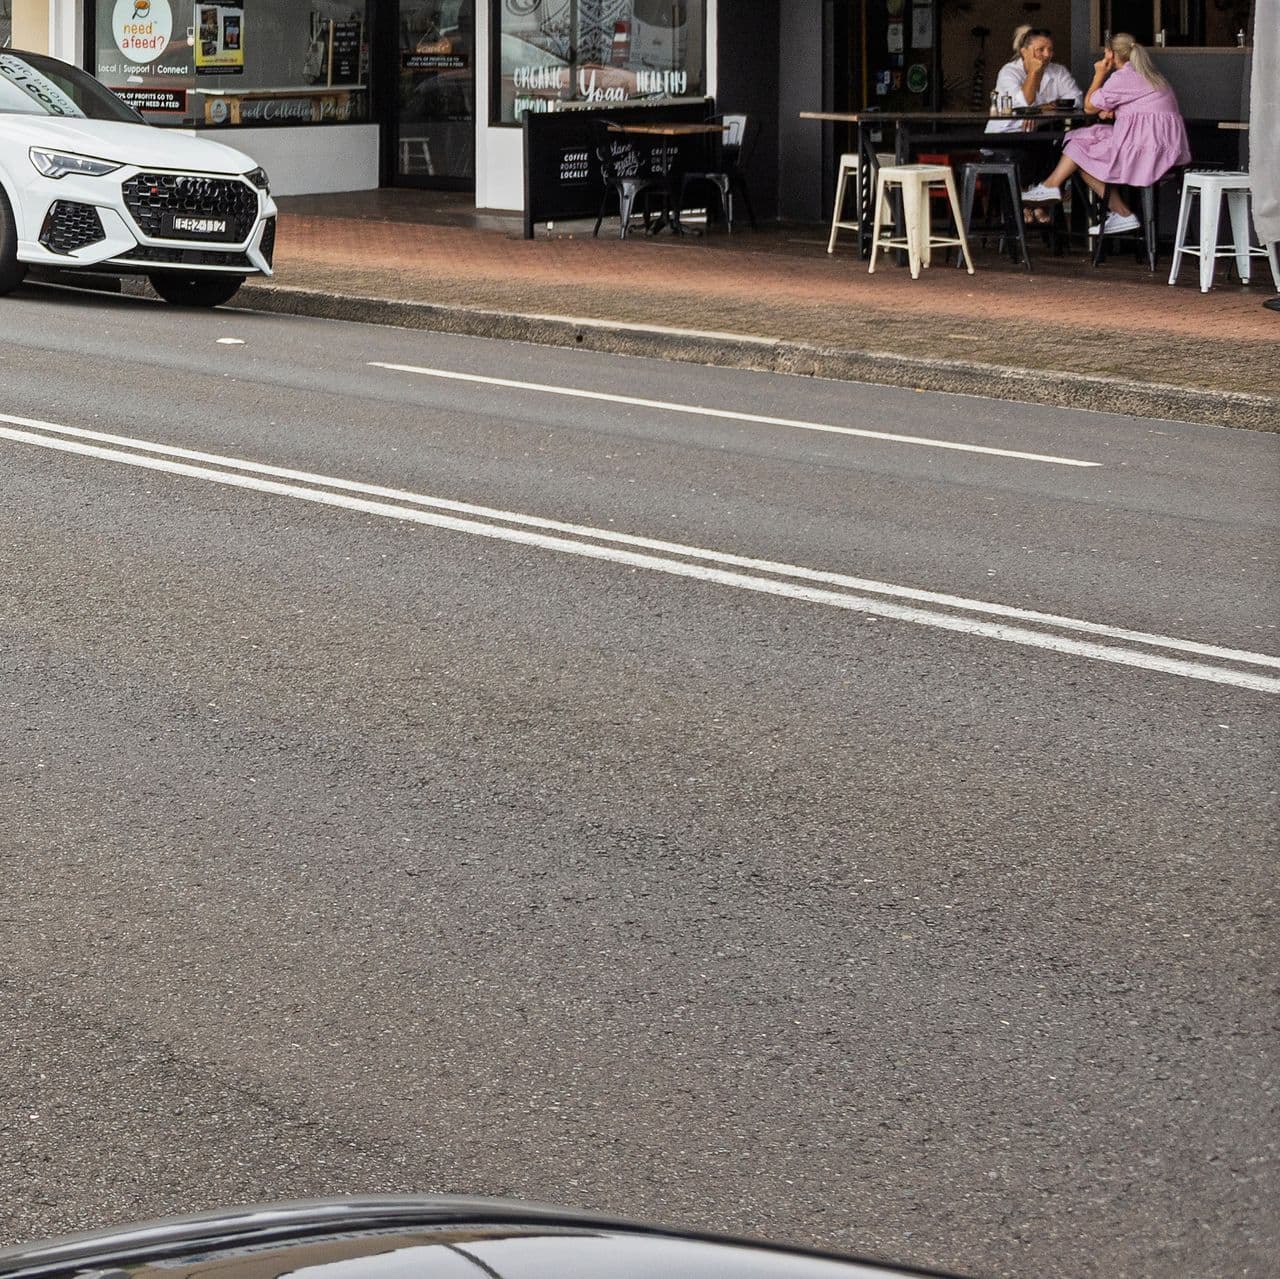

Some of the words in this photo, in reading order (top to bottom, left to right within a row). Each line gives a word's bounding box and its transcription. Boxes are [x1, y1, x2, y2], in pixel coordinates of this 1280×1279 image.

[123, 22, 153, 34] need
[98, 64, 117, 74] Local
[123, 63, 150, 76] Support
[157, 64, 188, 74] Connect
[513, 66, 563, 90] ORGANIC
[636, 70, 688, 94] HEALTHY
[126, 92, 134, 100] OF
[135, 92, 156, 100] PROFITS
[157, 92, 166, 100] GO
[146, 100, 160, 108] NEED
[263, 98, 315, 121] Collection
[563, 152, 589, 162] COFFEE
[560, 162, 589, 170] ROASTED
[560, 170, 589, 179] LOCALLY
